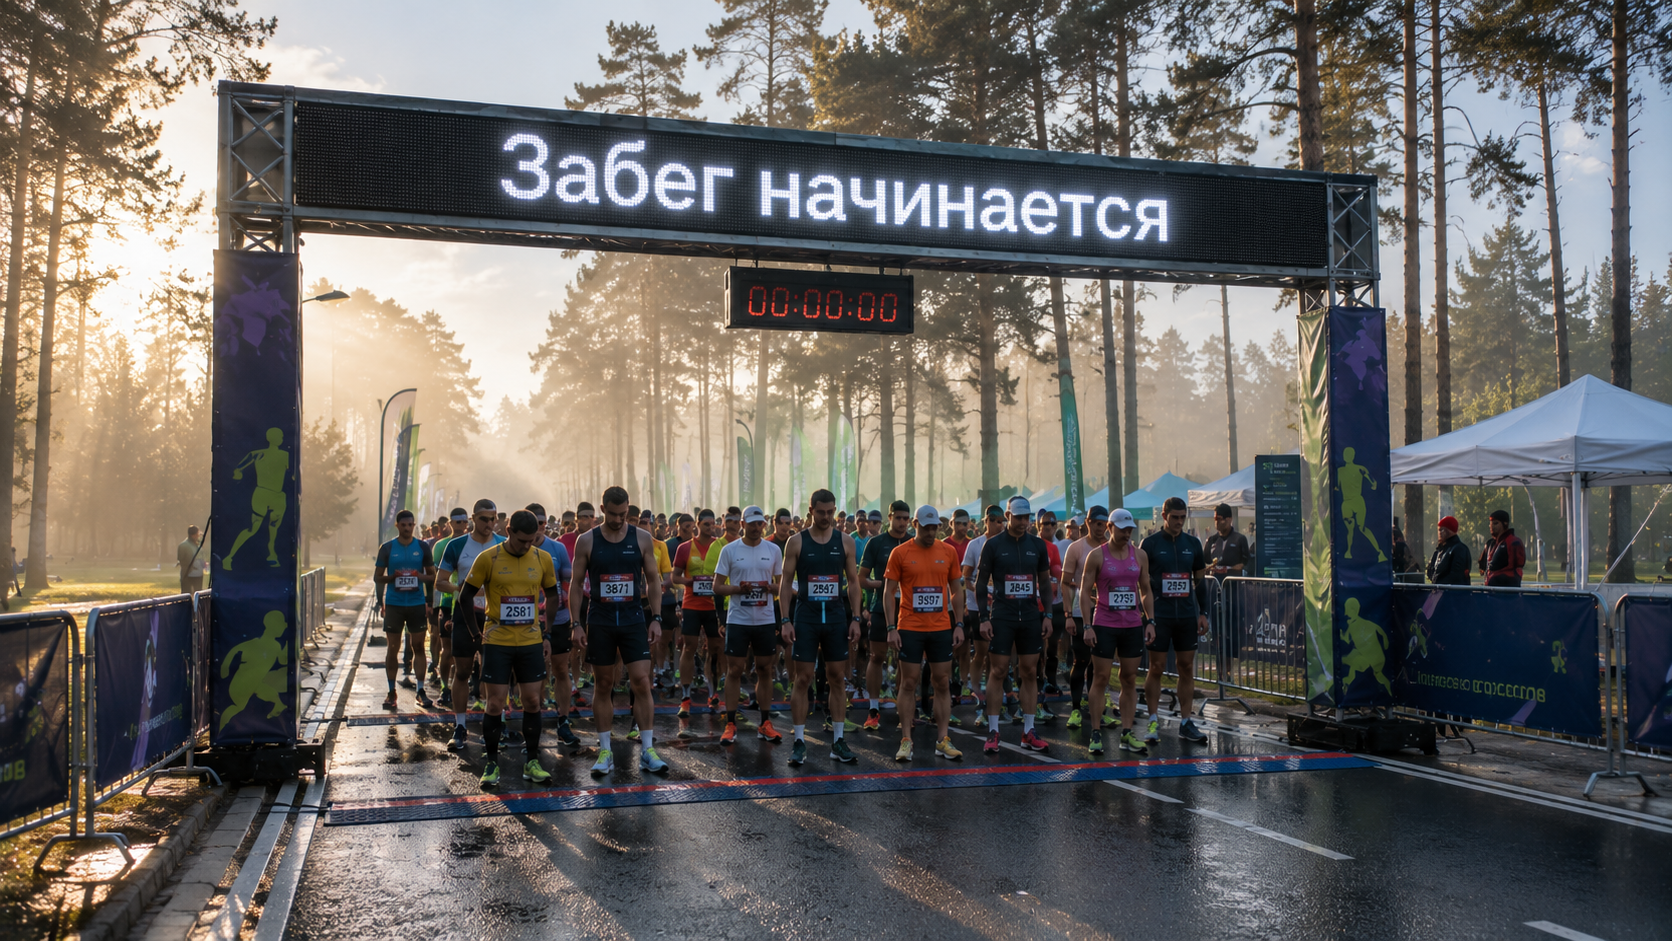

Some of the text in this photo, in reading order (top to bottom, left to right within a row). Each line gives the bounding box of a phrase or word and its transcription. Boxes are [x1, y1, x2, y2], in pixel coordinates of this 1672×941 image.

[501, 133, 1170, 244] Забег начинается
[748, 285, 898, 322] 00:00:00
[605, 583, 629, 594] 3871
